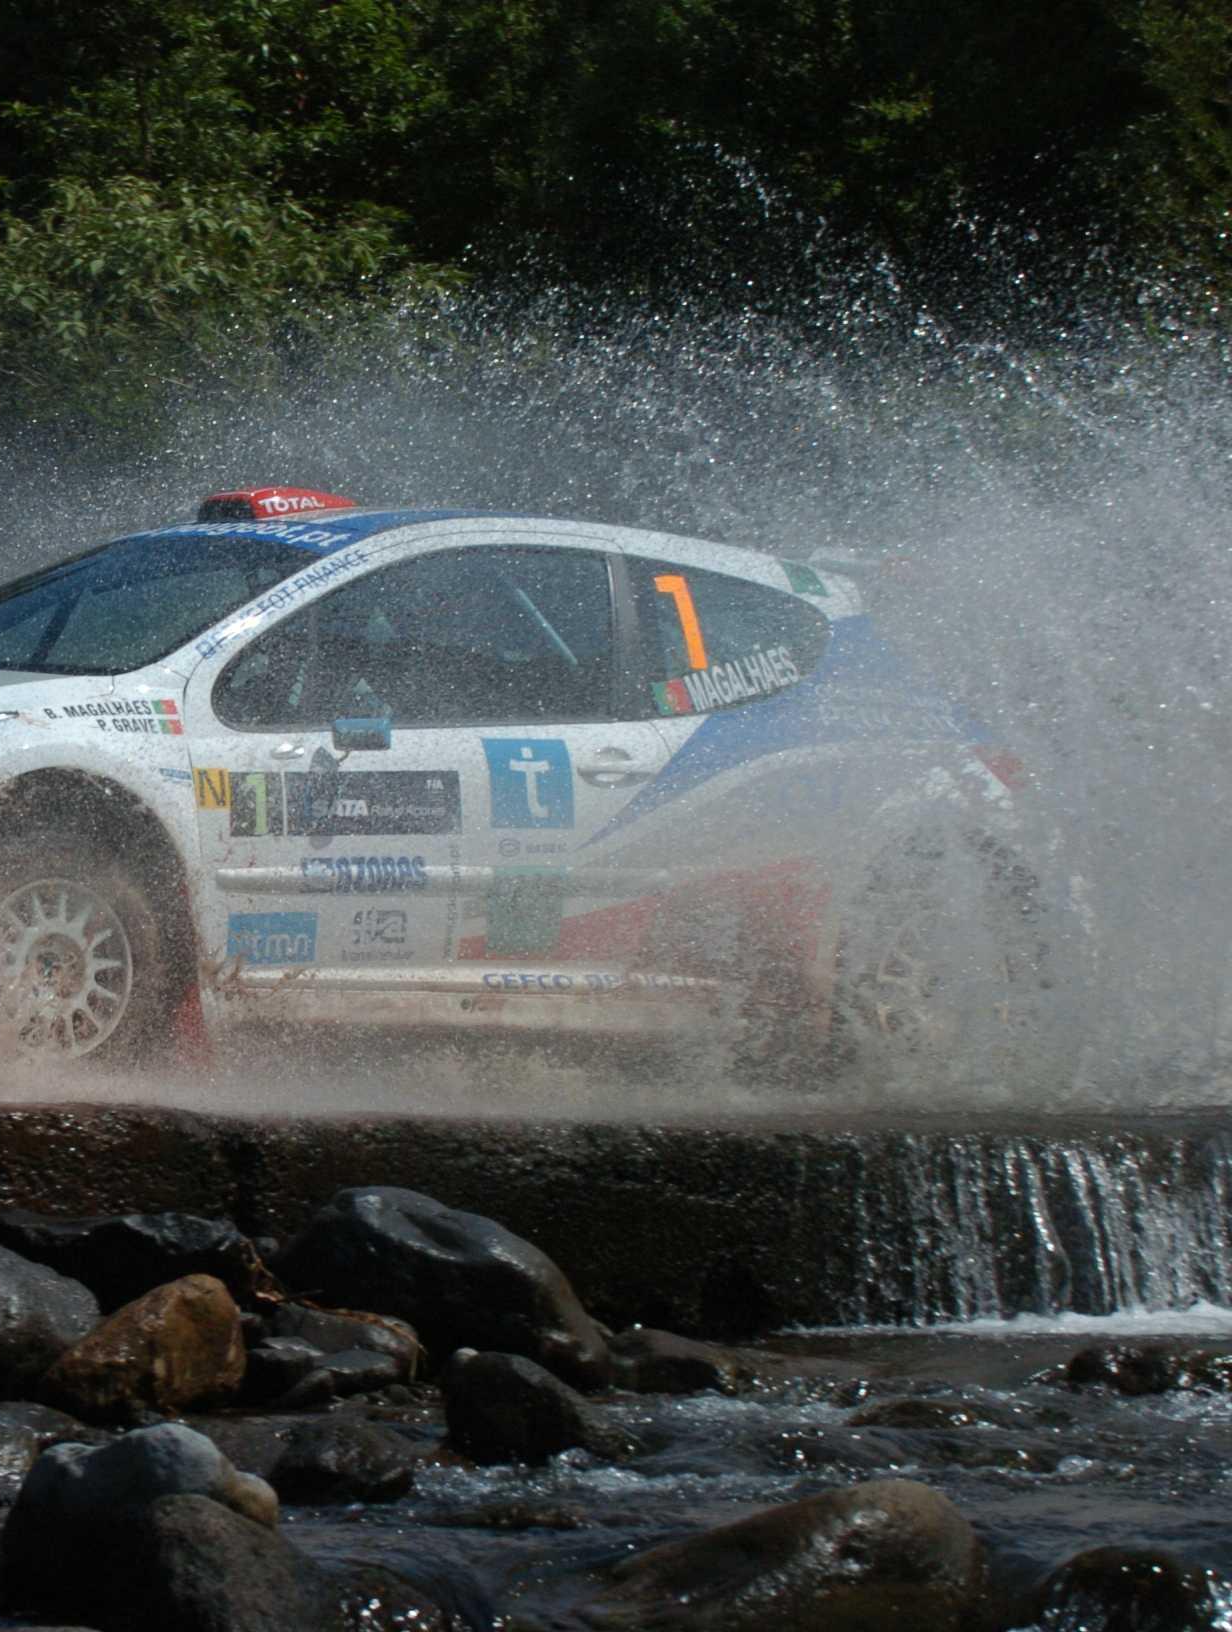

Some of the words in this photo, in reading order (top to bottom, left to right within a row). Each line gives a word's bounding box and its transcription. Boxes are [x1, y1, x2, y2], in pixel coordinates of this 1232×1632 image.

[258, 496, 325, 512] TOTAL
[294, 548, 369, 589] FINANCE
[43, 707, 63, 719] B.
[97, 719, 112, 732] P.
[112, 719, 159, 734] GRAVE
